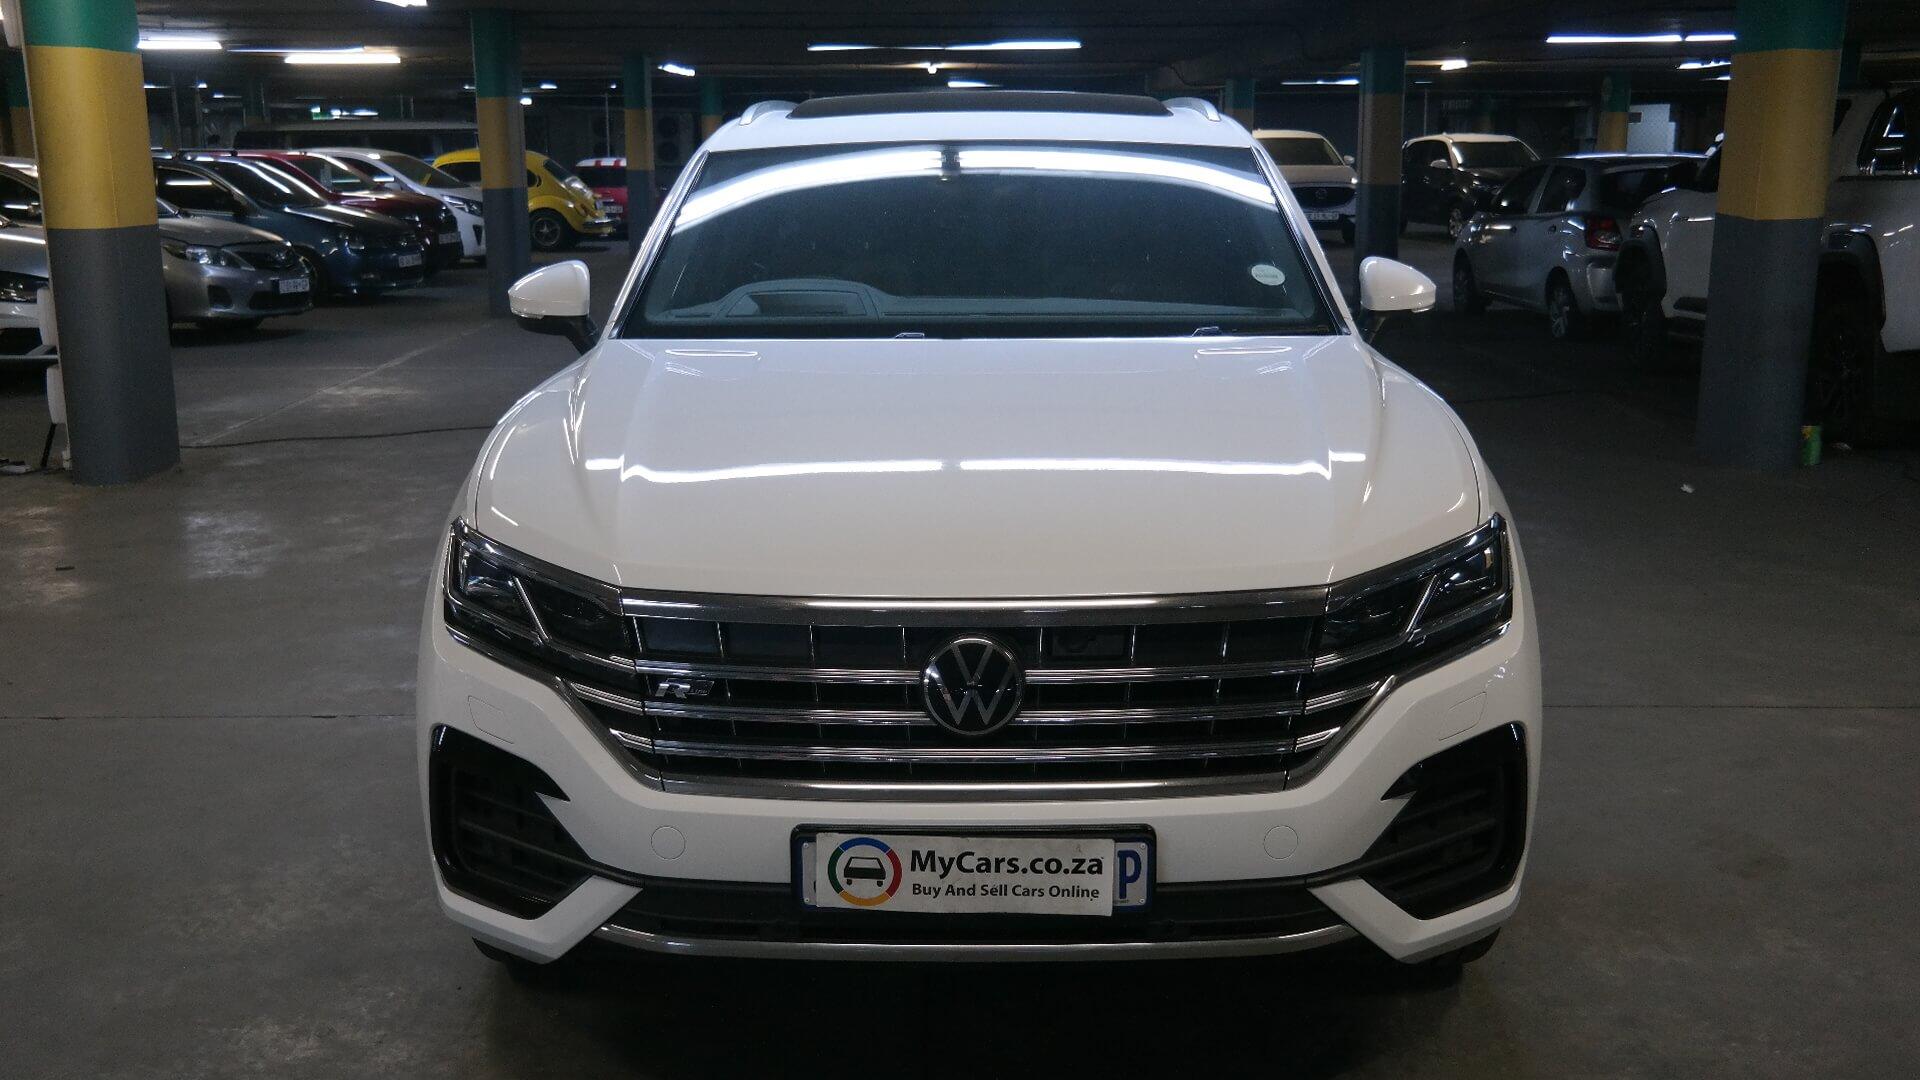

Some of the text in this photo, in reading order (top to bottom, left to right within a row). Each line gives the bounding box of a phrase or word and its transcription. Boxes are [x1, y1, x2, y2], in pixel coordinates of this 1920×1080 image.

[910, 849, 1104, 880] MyCars.co.za
[1117, 849, 1142, 900] P
[912, 883, 1100, 899] Buy And Sell Cars Online
